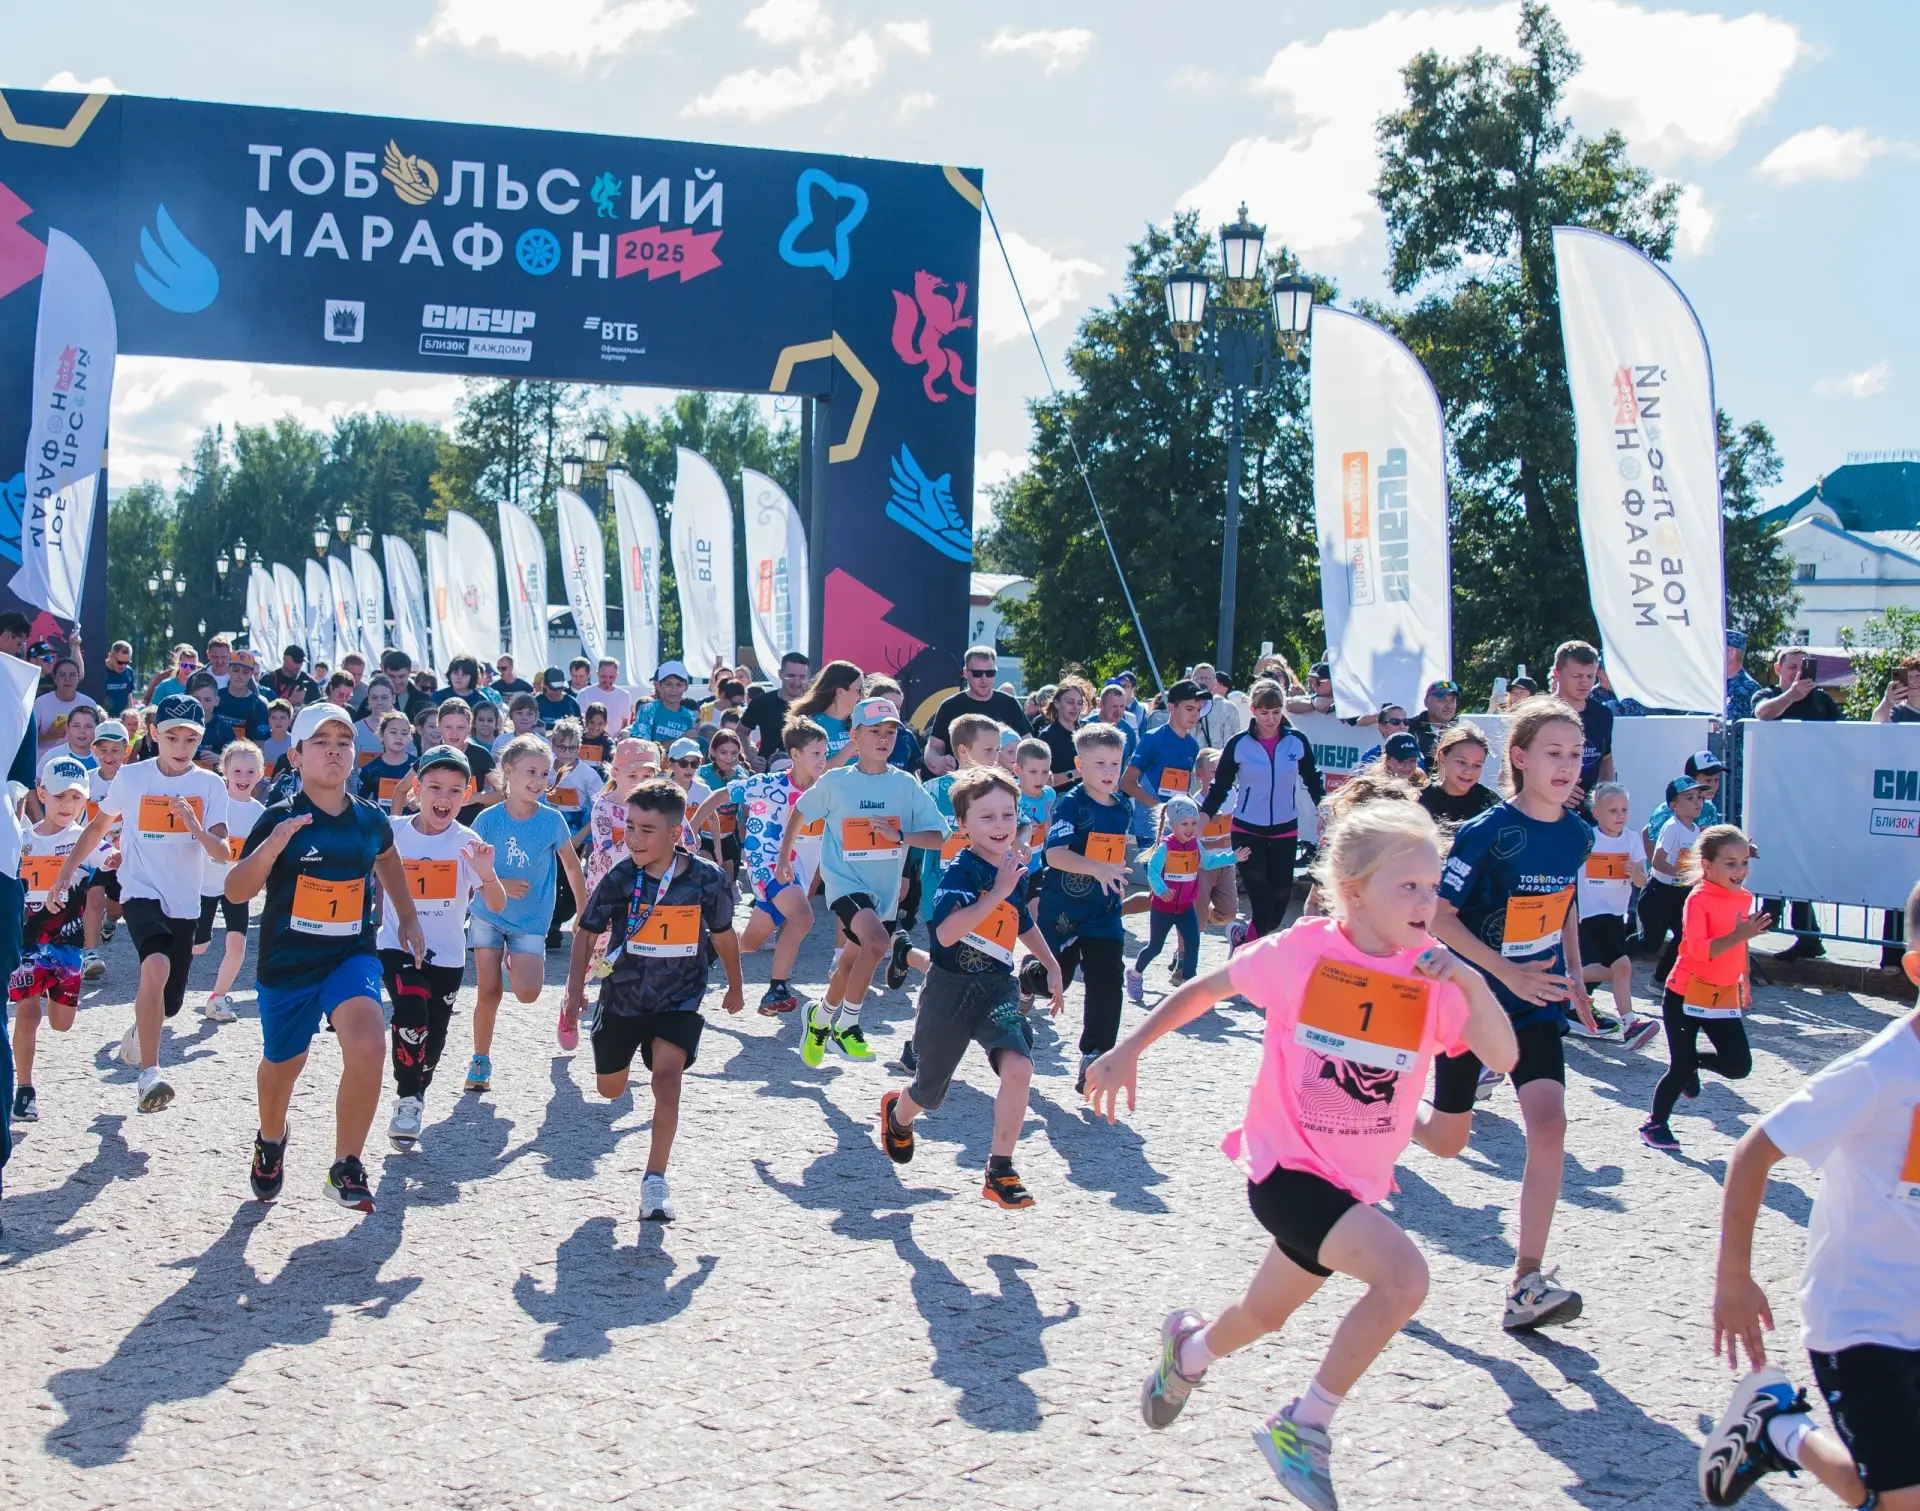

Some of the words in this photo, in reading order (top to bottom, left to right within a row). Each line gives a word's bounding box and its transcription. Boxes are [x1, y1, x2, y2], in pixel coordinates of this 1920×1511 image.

[245, 207, 610, 279] МАРАФОН
[624, 240, 685, 263] 2025
[422, 304, 536, 334] СИБУР
[601, 322, 639, 341] ВТБ
[424, 340, 466, 352] БЛИЗОК
[473, 343, 528, 355] КАЖДОМУ
[1873, 769, 1920, 801] СИ
[167, 813, 174, 828] 1
[1875, 815, 1915, 830] БЛИЗОК
[868, 831, 876, 846] 1
[1107, 848, 1112, 861] 1
[32, 871, 39, 887] 1
[417, 877, 425, 895] 1
[329, 899, 338, 918] 1
[660, 923, 668, 941] 1
[995, 919, 1004, 938] 1
[1539, 914, 1546, 934] 1
[1712, 992, 1719, 1006] 1
[1358, 1001, 1374, 1032] 1
[1305, 1030, 1345, 1047] СИБУР
[1299, 1120, 1334, 1134] CREATE
[1362, 1126, 1396, 1135] STORIES
